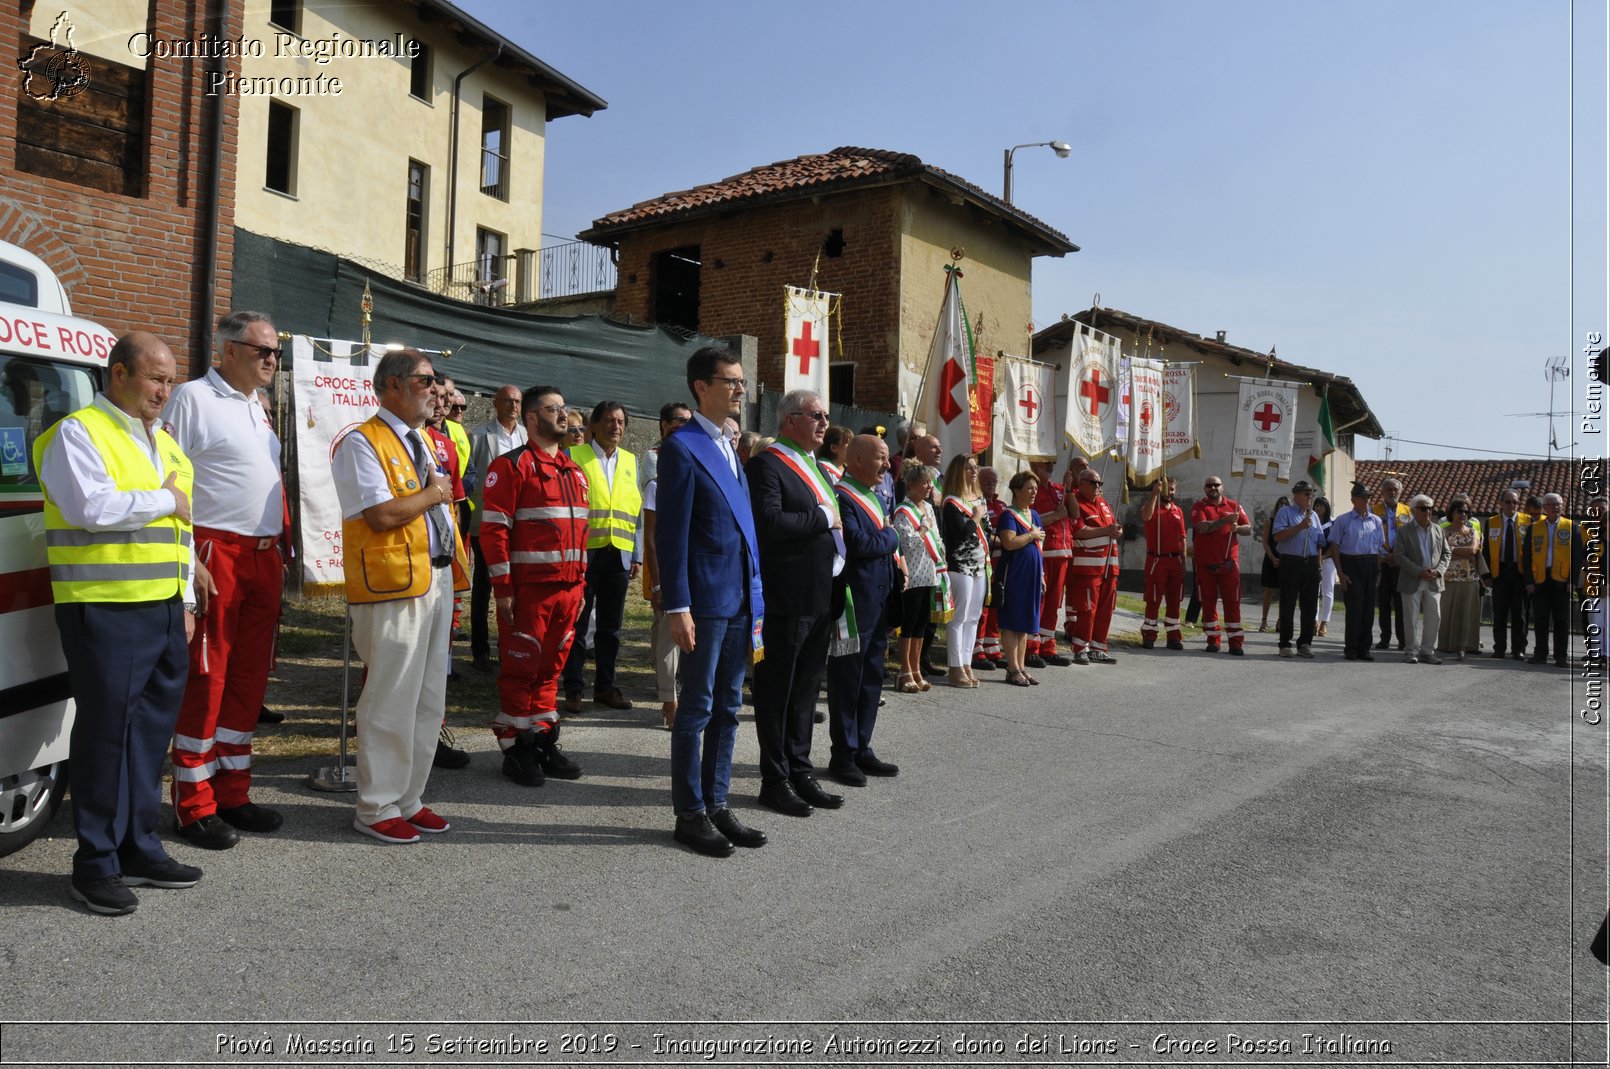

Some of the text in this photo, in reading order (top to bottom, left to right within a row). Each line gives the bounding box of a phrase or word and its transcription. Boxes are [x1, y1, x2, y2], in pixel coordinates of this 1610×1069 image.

[0, 316, 51, 350] OCE
[315, 375, 357, 390] CROCE
[332, 393, 380, 407] ITALIAN
